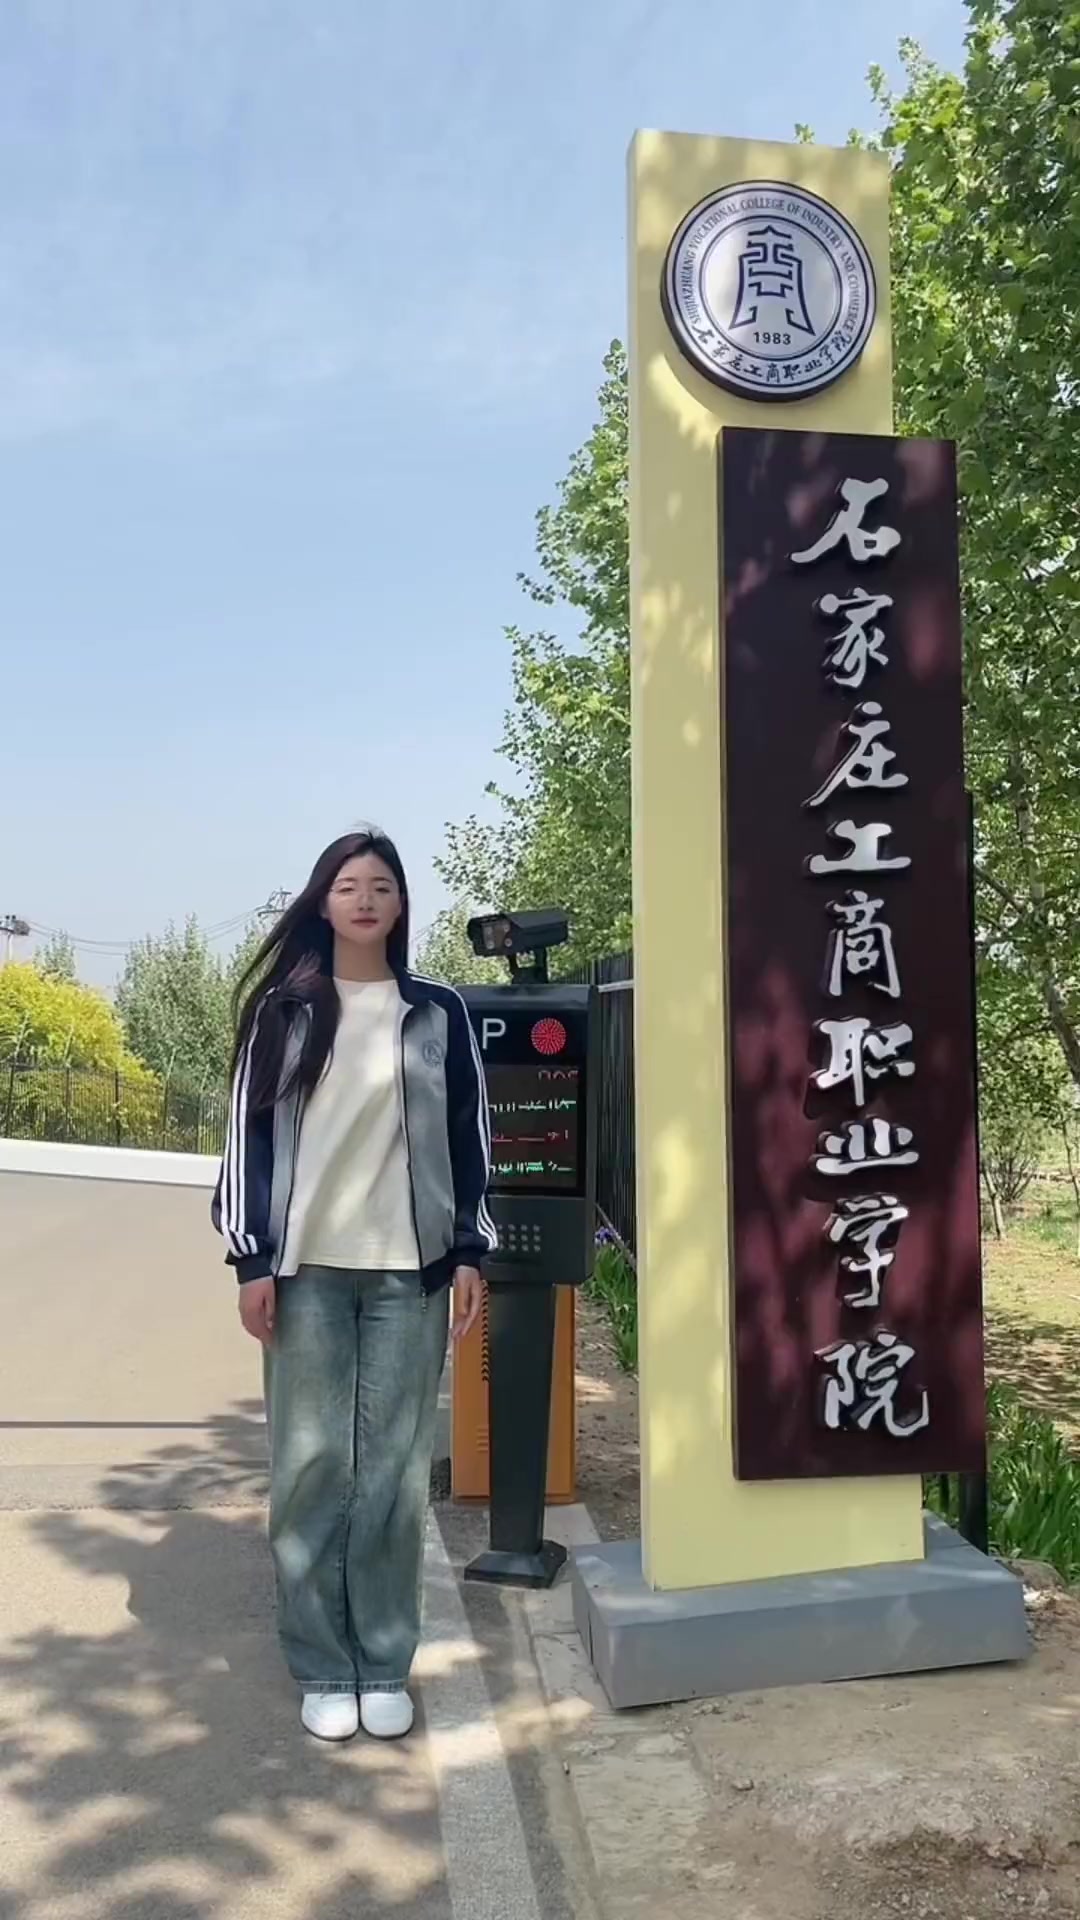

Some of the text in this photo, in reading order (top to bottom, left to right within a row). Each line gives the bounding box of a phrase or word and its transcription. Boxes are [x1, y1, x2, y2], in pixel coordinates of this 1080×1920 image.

[687, 203, 739, 249] VOCATIONAL
[740, 197, 785, 211] COLLEGE
[787, 203, 801, 215] OF
[802, 208, 843, 249] INDUSTRY
[692, 325, 853, 383] 石家庄工商职业学院
[753, 331, 792, 346] 1983
[790, 476, 930, 1437] 石家庄工商职业学院
[482, 1017, 507, 1050] P
